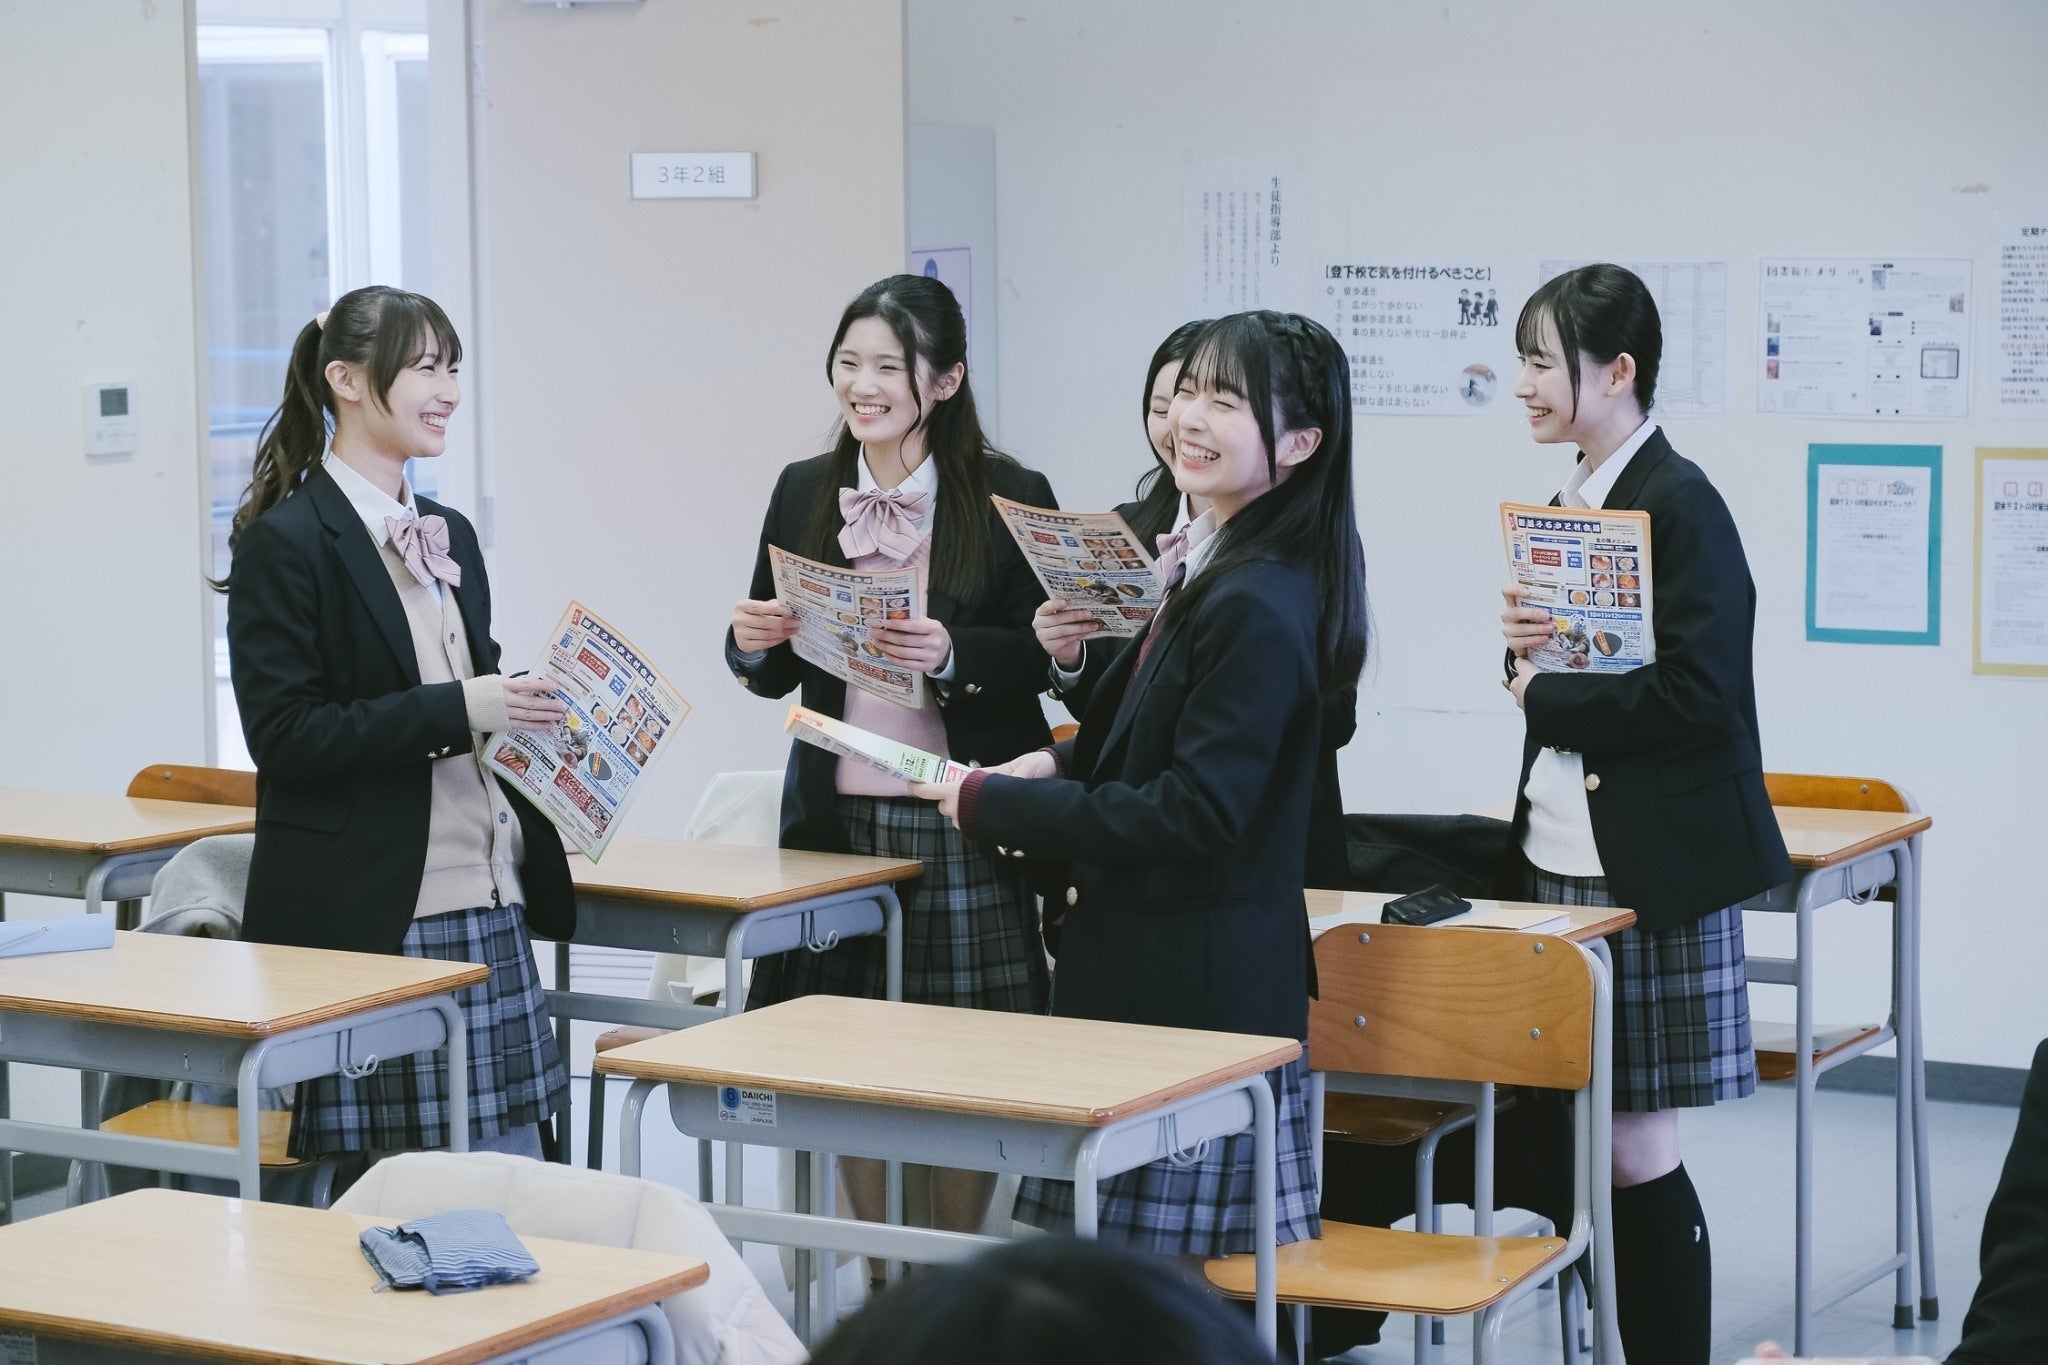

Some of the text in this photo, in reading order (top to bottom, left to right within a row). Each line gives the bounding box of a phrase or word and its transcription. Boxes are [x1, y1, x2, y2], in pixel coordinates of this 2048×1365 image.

[658, 165, 725, 183] 3年2組
[1270, 176, 1281, 267] 生徒指導部より
[741, 1091, 773, 1101] DAIICHI
